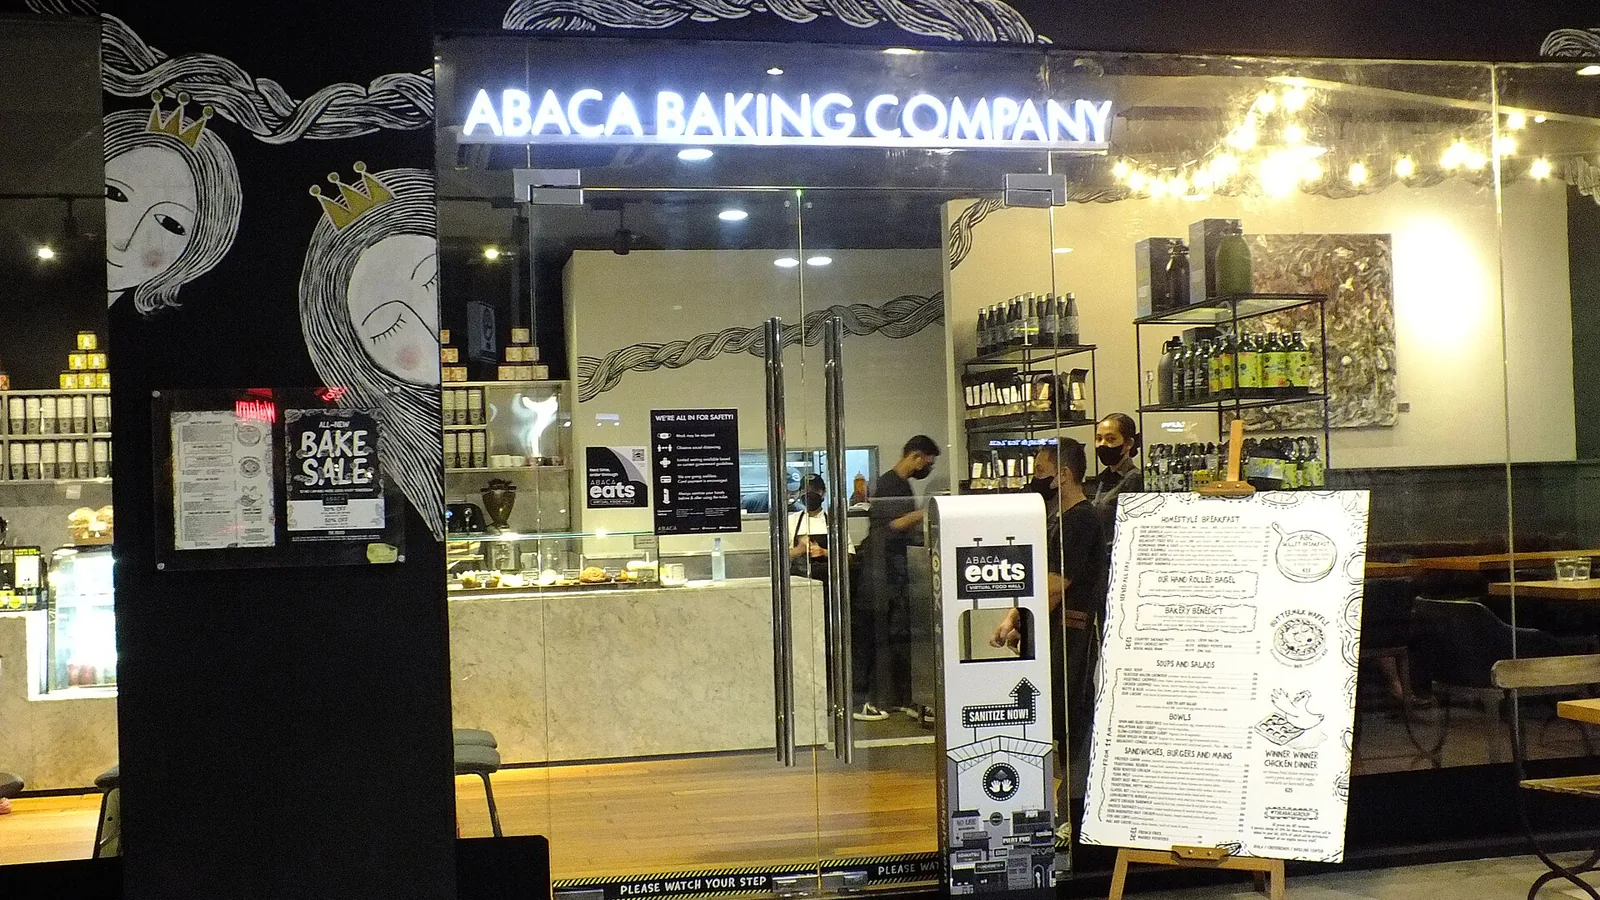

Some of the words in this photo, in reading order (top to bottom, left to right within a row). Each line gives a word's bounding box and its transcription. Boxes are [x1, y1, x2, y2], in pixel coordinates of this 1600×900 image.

[463, 87, 644, 137] ABACA
[655, 91, 855, 140] BAKING
[865, 94, 1112, 144] COMPANY
[318, 420, 350, 429] ALL-NEW
[301, 429, 369, 458] BAKE
[302, 457, 369, 486] SALE
[590, 482, 635, 498] eats
[1161, 515, 1198, 523] HOMESTYLE
[1201, 515, 1240, 523] BREAKFAST
[965, 555, 1000, 564] ABACA
[964, 558, 1026, 583] eats
[1189, 576, 1213, 584] ROLLED
[1215, 576, 1235, 584] BAGEL
[1165, 607, 1190, 615] BAKERY
[1192, 607, 1224, 615] BENEDICT
[1270, 609, 1306, 628] BUTTERMILK
[1308, 610, 1330, 626] WAFFLE
[1176, 660, 1189, 668] AND
[1191, 660, 1215, 669] SALADS
[969, 710, 1006, 722] SANITIZE
[1007, 708, 1029, 720] NOW!
[1169, 713, 1191, 721] BOWLS
[1106, 727, 1112, 737] AM
[1105, 738, 1111, 747] 11
[1124, 746, 1165, 757] SANDWICHES,
[1166, 748, 1195, 757] BURGERS
[1196, 750, 1210, 759] AND
[1212, 751, 1233, 760] MAINS
[1265, 750, 1290, 758] WINNER
[1293, 751, 1318, 759] WINNER
[1264, 759, 1292, 768] CHICKEN
[1294, 761, 1318, 769] DINNER
[878, 863, 916, 876] PLEASE
[620, 883, 663, 895] PLEASE
[665, 880, 703, 892] WATCH
[705, 878, 736, 889] YOUR
[740, 876, 768, 887] STEP
